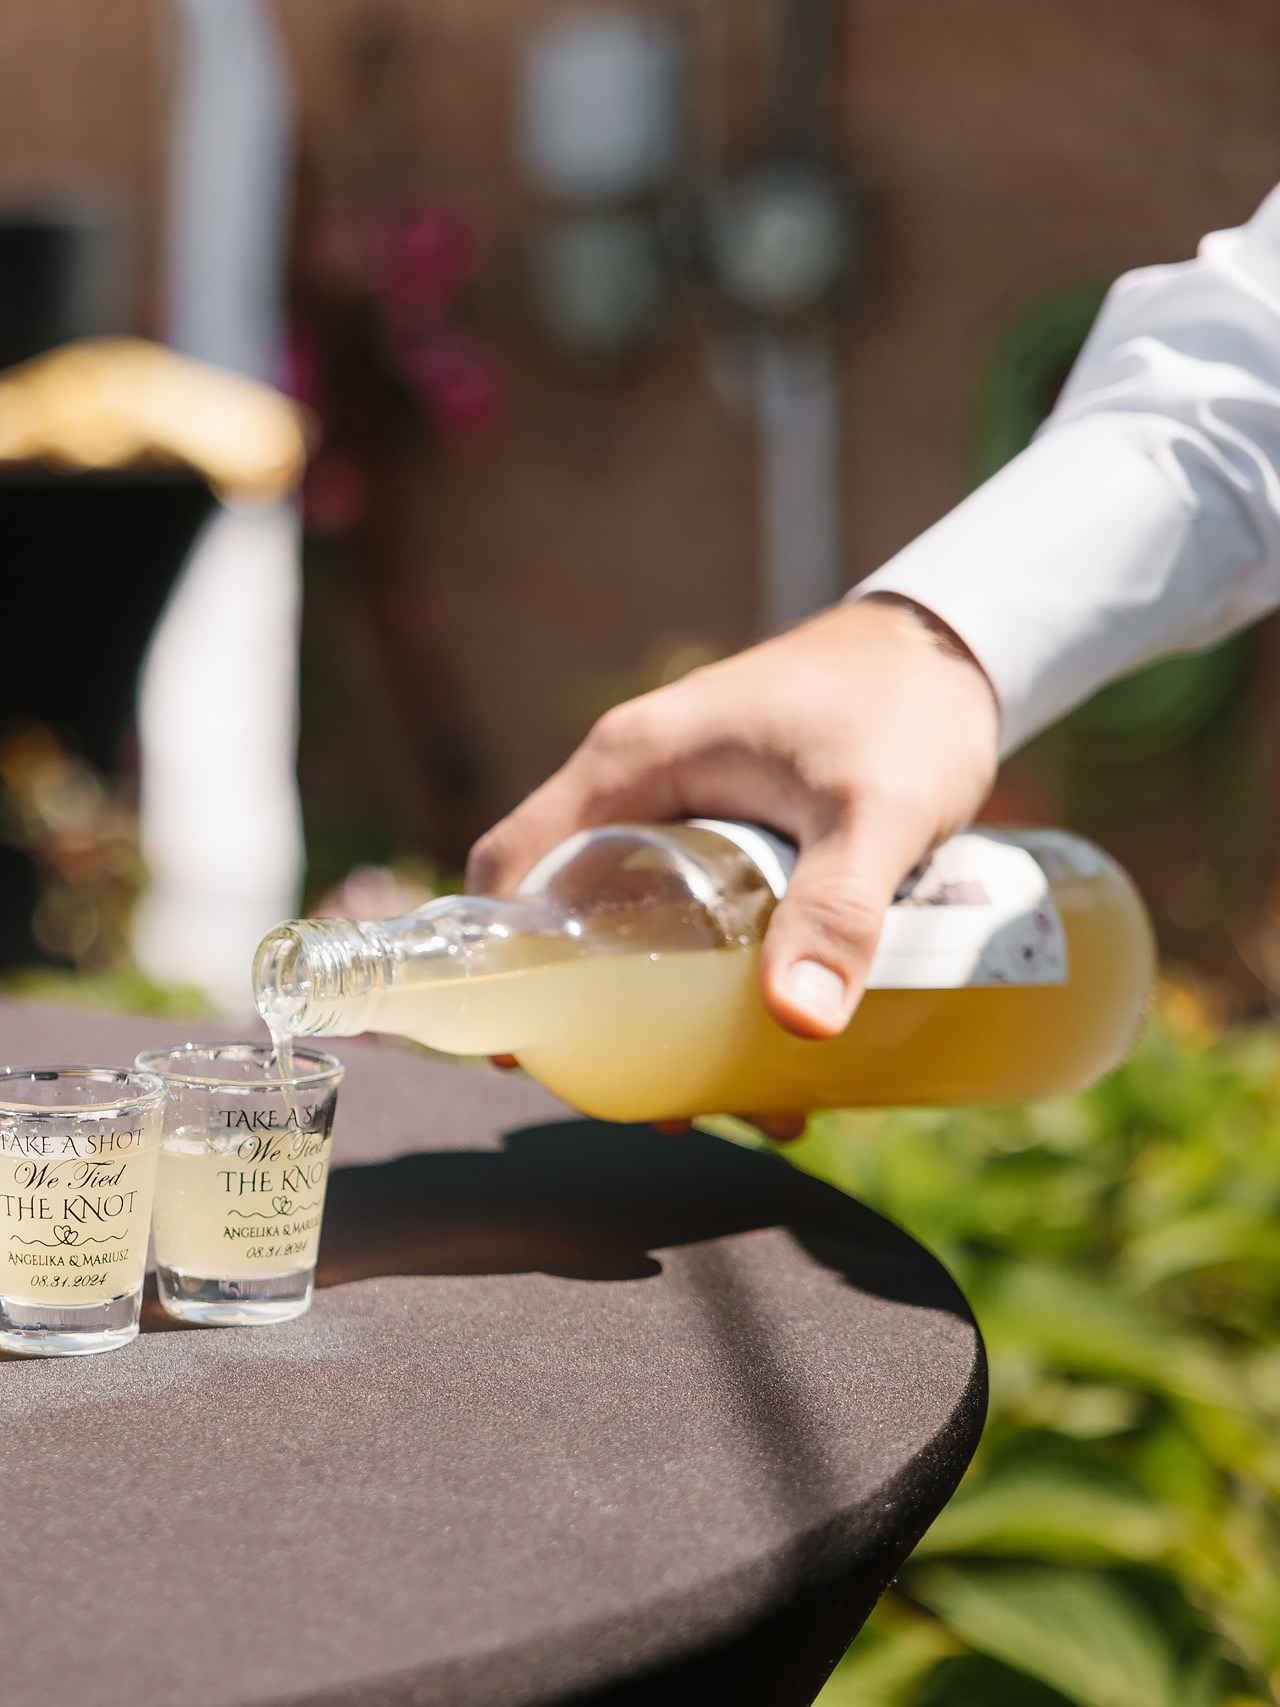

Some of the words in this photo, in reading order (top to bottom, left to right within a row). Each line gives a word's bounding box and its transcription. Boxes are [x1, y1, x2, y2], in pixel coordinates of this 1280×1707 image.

[219, 1109, 277, 1132] TAKE
[285, 1107, 301, 1128] A
[62, 1135, 82, 1157] A
[85, 1128, 145, 1155] SHOT
[237, 1130, 289, 1164] We
[13, 1159, 77, 1190] We
[67, 1160, 127, 1190] Tied
[217, 1168, 273, 1196] THE
[281, 1160, 325, 1193] KNO
[0, 1194, 53, 1222] THE
[63, 1190, 138, 1224] KNOT
[223, 1226, 279, 1240] ANGELIKA
[282, 1224, 291, 1235] &
[8, 1250, 65, 1267] ANGELIKA
[69, 1254, 82, 1267] &
[82, 1249, 129, 1267] MARIUSZ
[30, 1271, 109, 1288] 08.31.2024
